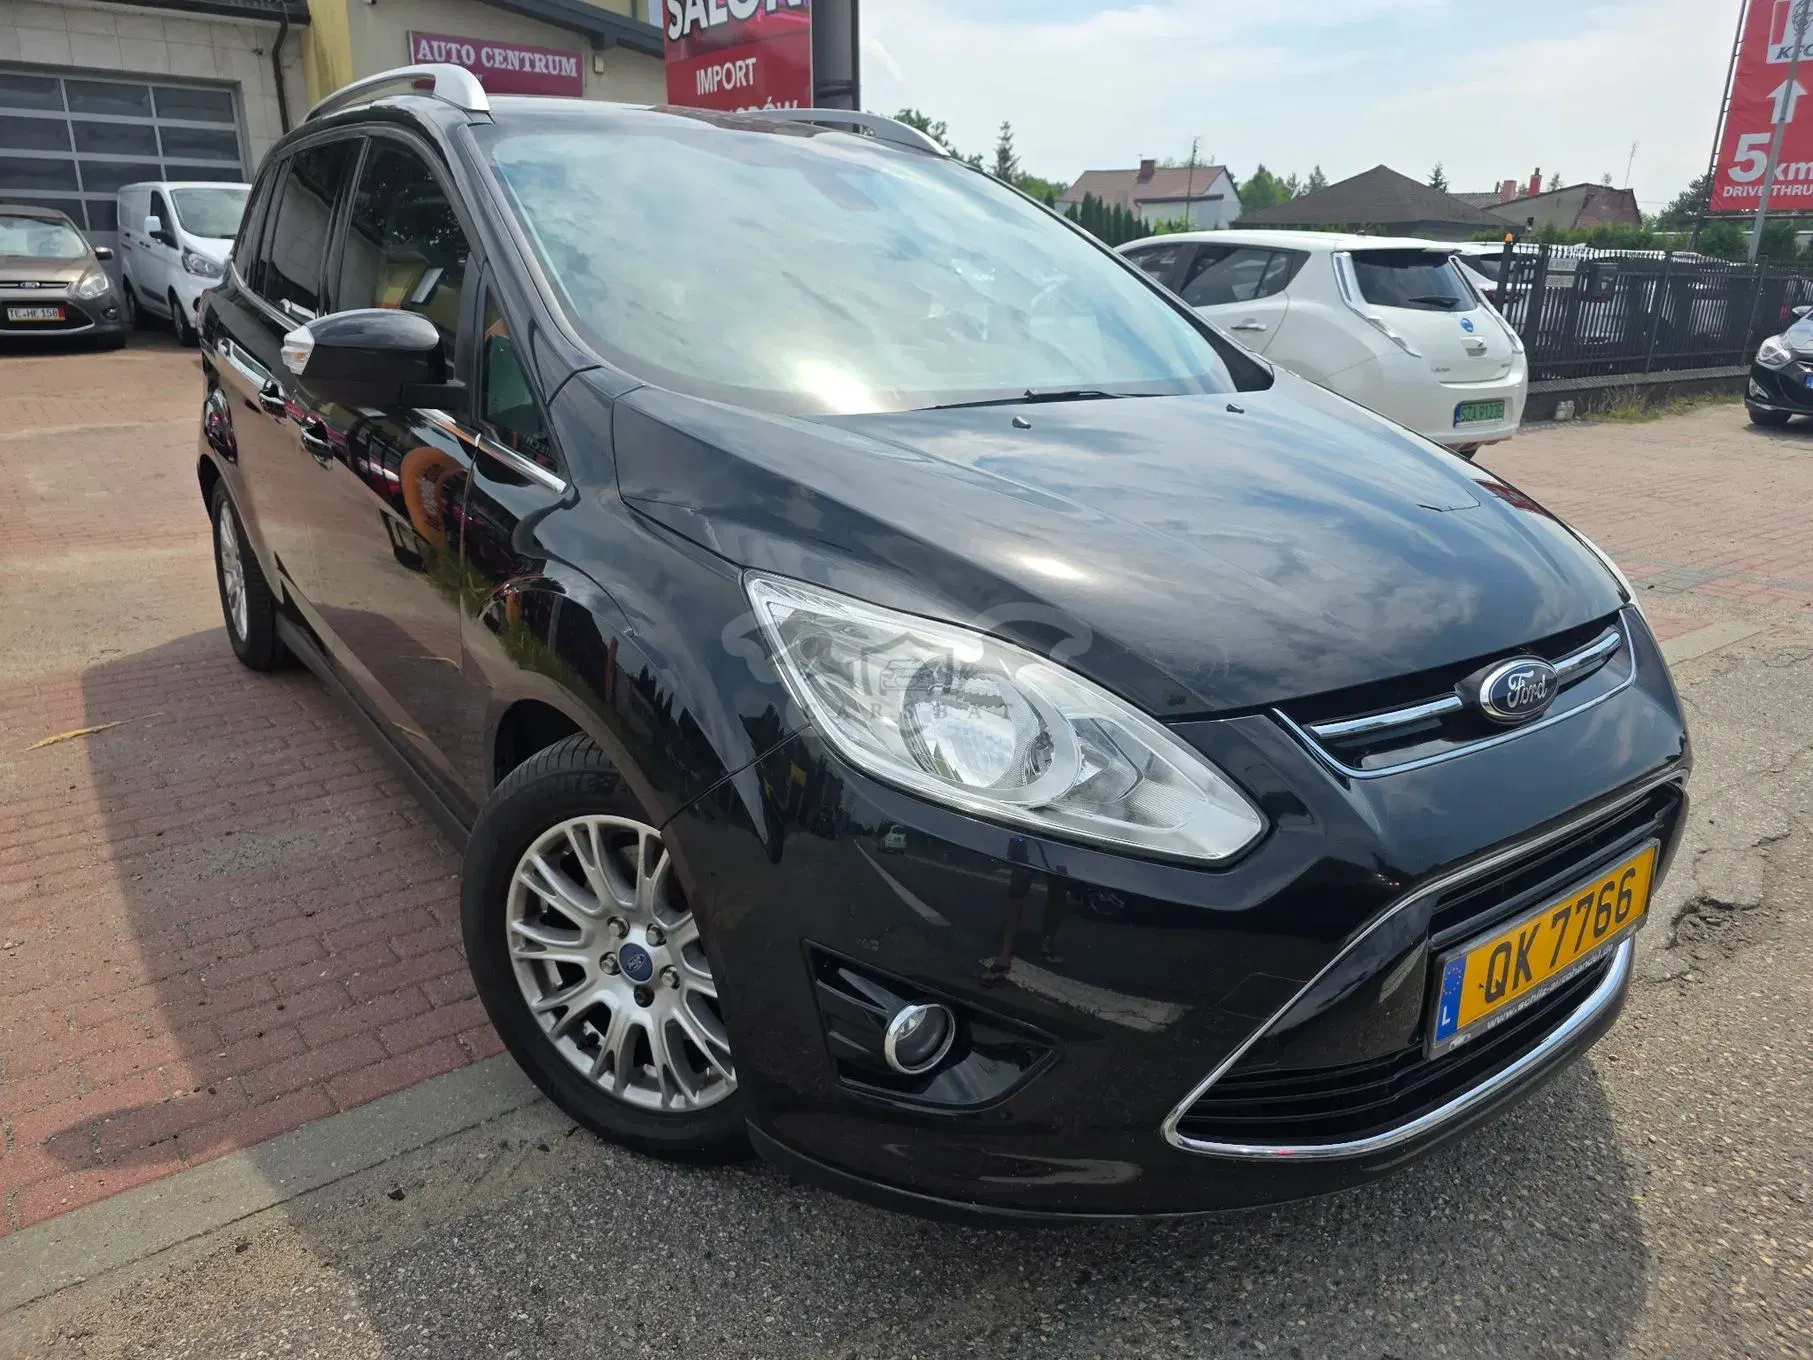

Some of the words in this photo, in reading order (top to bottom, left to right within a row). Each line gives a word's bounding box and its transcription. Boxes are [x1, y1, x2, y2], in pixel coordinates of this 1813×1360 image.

[668, 0, 801, 40] SAL
[417, 39, 476, 66] AUTO
[481, 47, 578, 77] CENTRUM
[696, 57, 757, 96] IMPORT
[1727, 132, 1771, 183] 5
[1507, 670, 1548, 708] Ford
[1485, 922, 1541, 1004] QK
[1549, 867, 1636, 969] 7766
[1441, 1006, 1451, 1026] L
